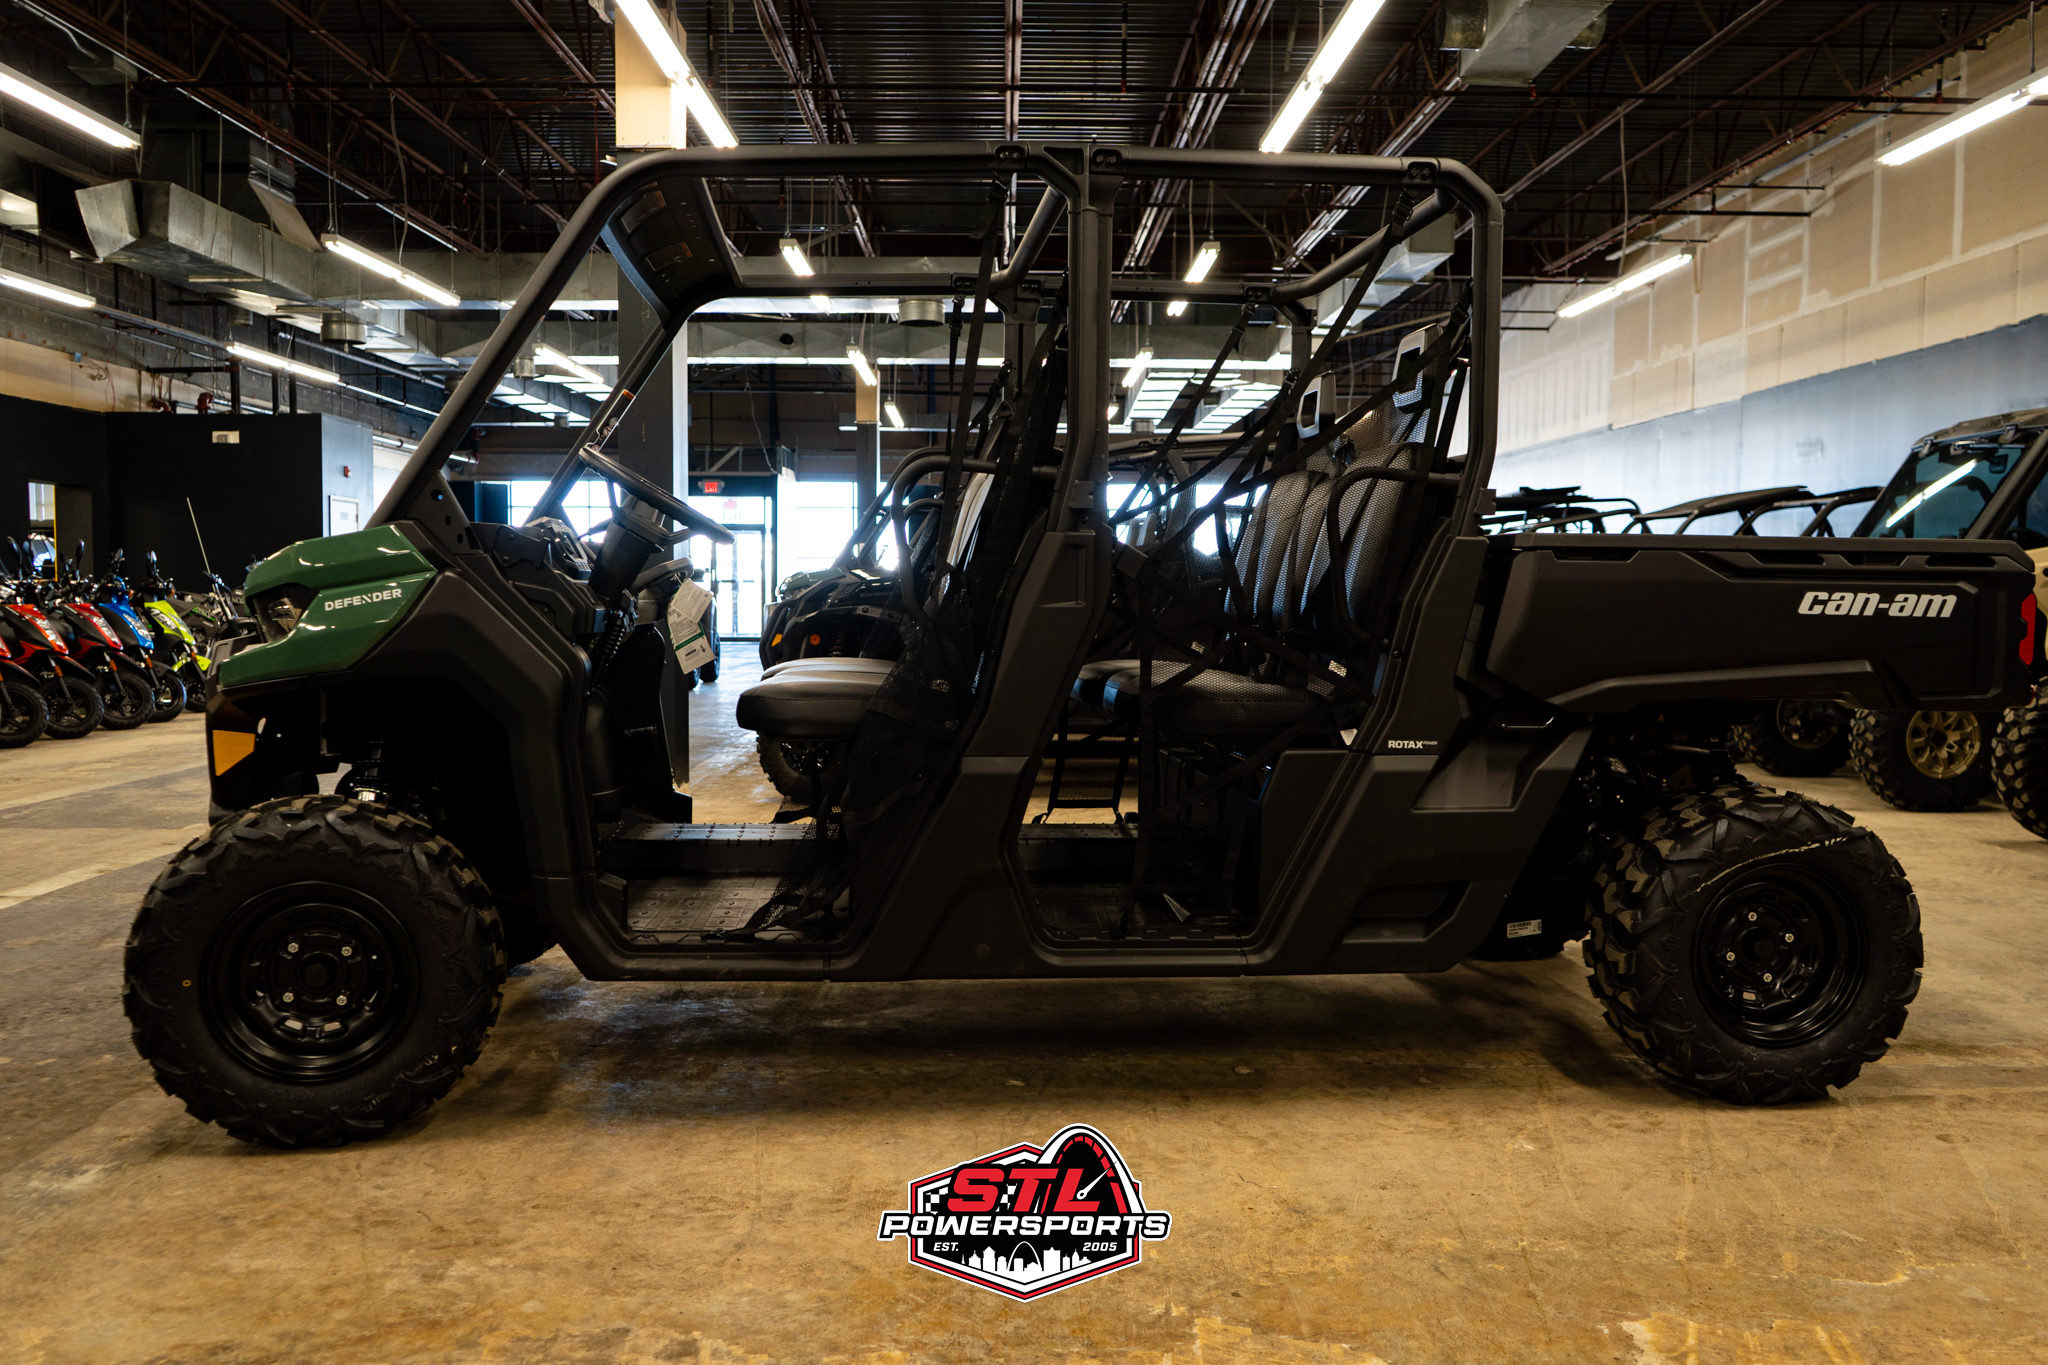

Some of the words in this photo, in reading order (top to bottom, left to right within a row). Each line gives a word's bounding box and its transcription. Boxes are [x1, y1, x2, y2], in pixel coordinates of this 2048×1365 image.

[704, 482, 718, 493] EXIT
[324, 588, 402, 611] DEFENDER
[1798, 591, 1957, 617] can-am
[1388, 740, 1423, 749] ROTAX
